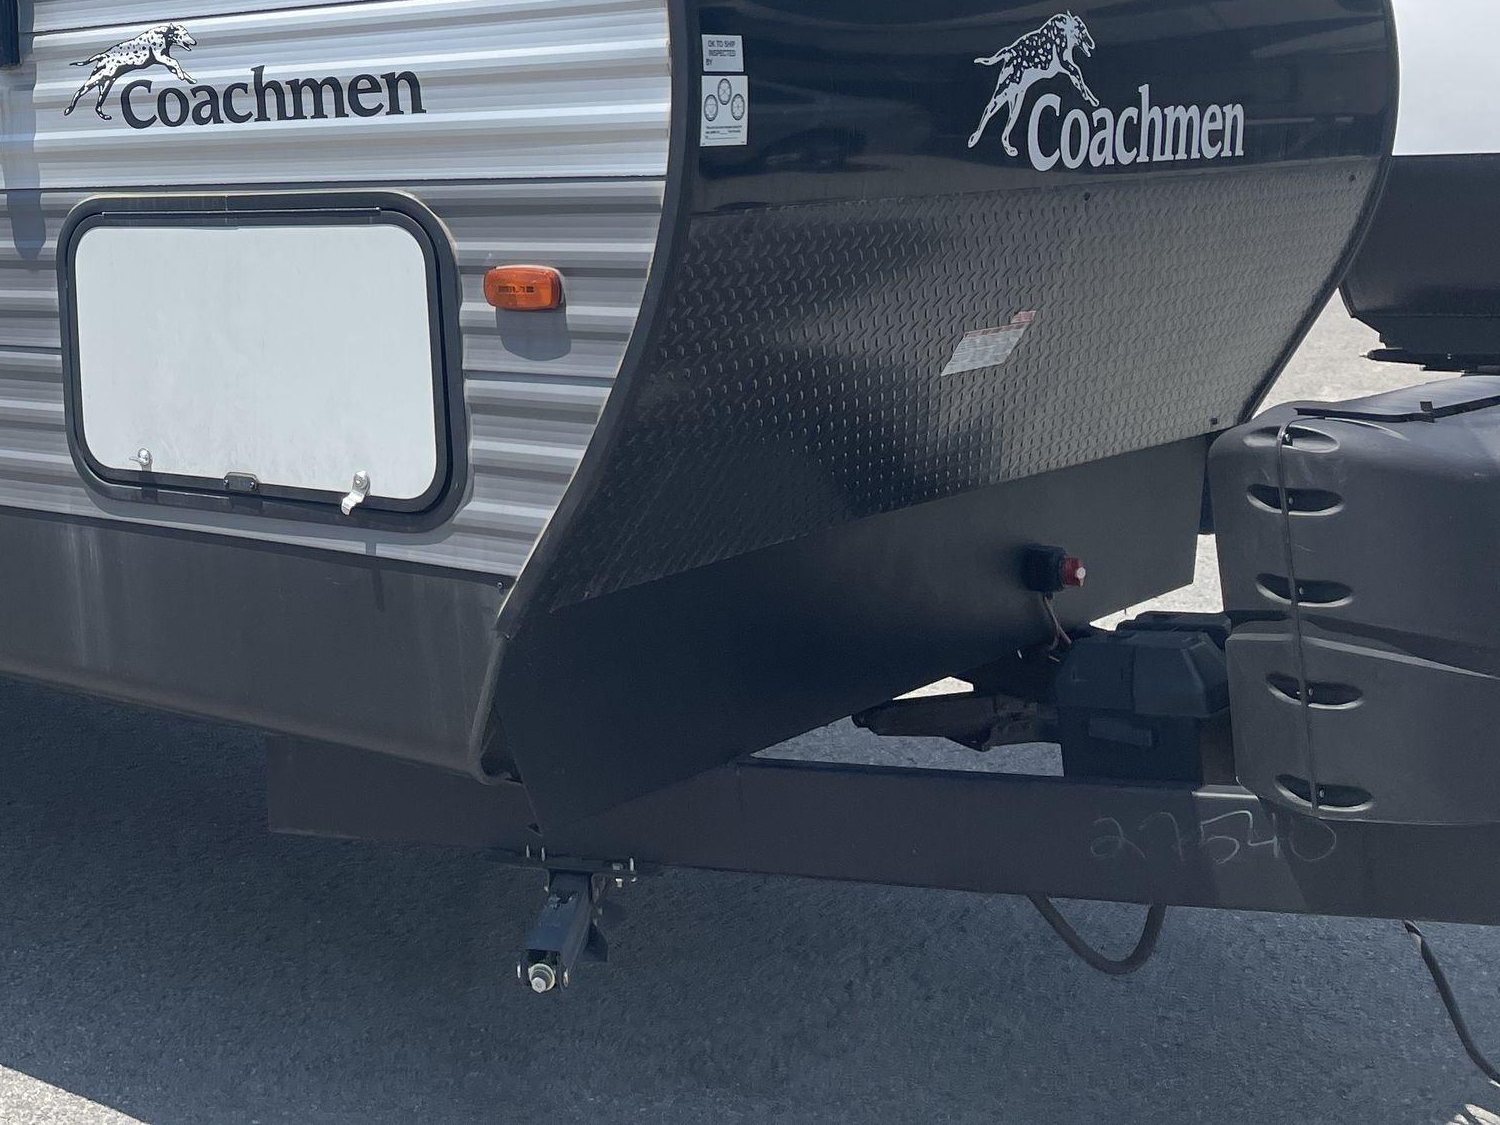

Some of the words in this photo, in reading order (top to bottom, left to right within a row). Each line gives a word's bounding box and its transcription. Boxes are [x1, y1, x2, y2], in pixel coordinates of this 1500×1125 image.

[120, 64, 427, 130] Coachmen
[1027, 83, 1245, 172] Coachmen
[1090, 810, 1338, 865] 27540
